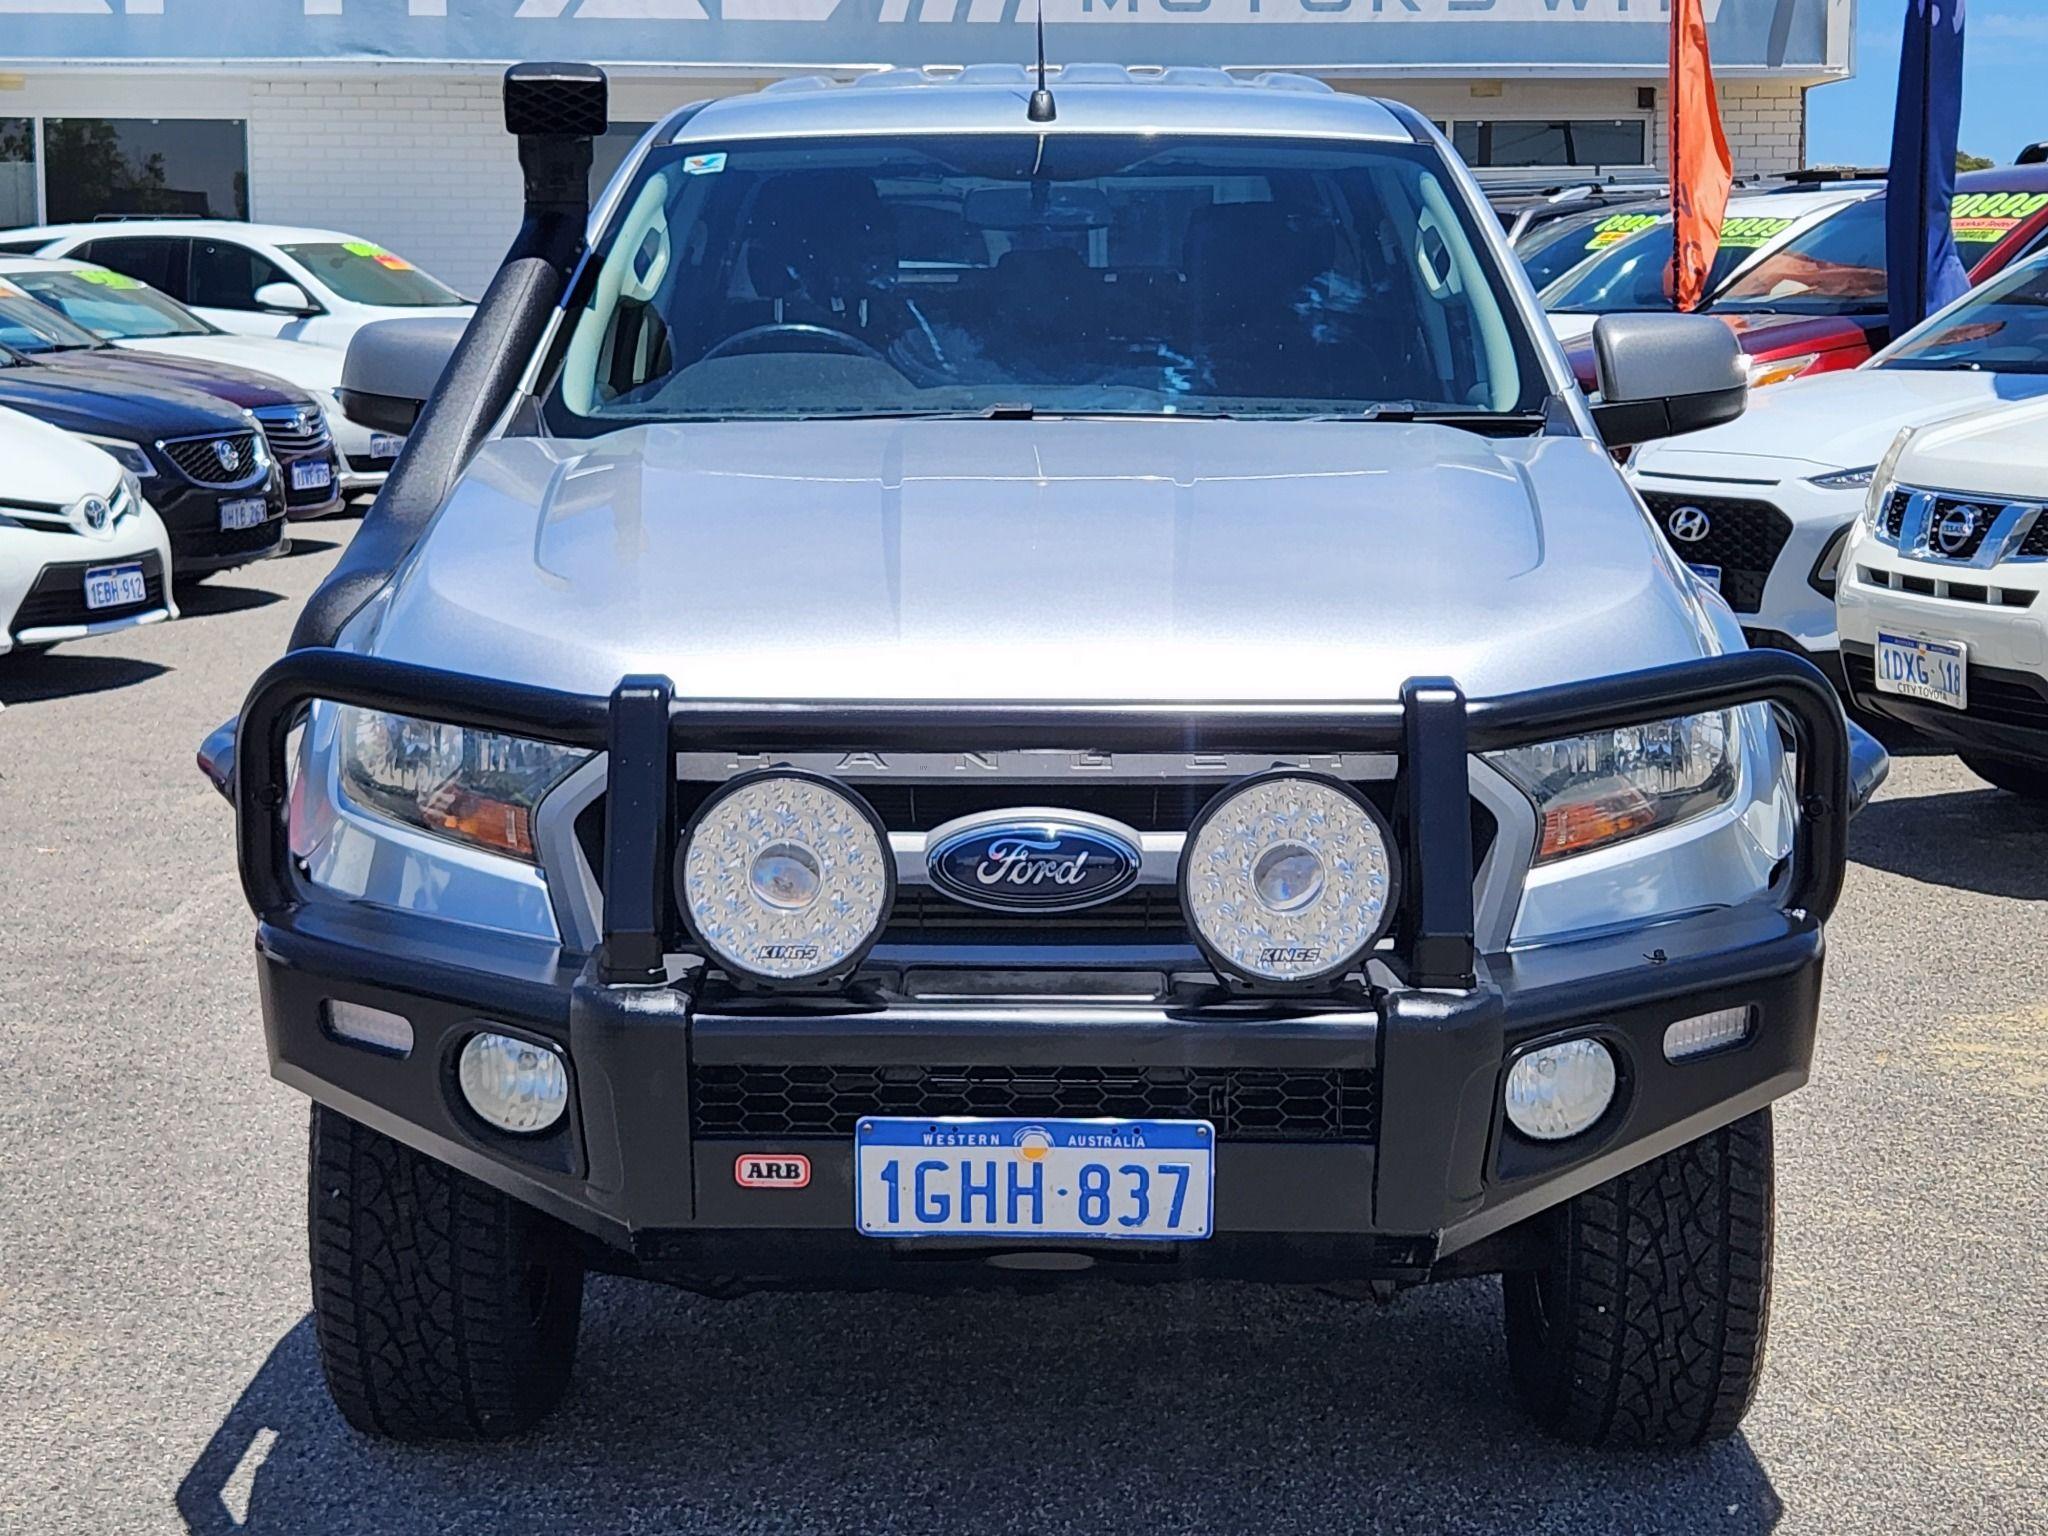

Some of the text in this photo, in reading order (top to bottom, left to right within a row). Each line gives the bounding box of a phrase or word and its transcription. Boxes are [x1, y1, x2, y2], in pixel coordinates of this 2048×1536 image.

[1897, 682, 1917, 694] CITY
[977, 838, 1089, 885] Ford
[759, 945, 819, 960] KINGS
[1260, 948, 1320, 962] KINGS
[923, 1133, 1146, 1149] WESTERN AUSTRALIA
[747, 1162, 801, 1180] ARB
